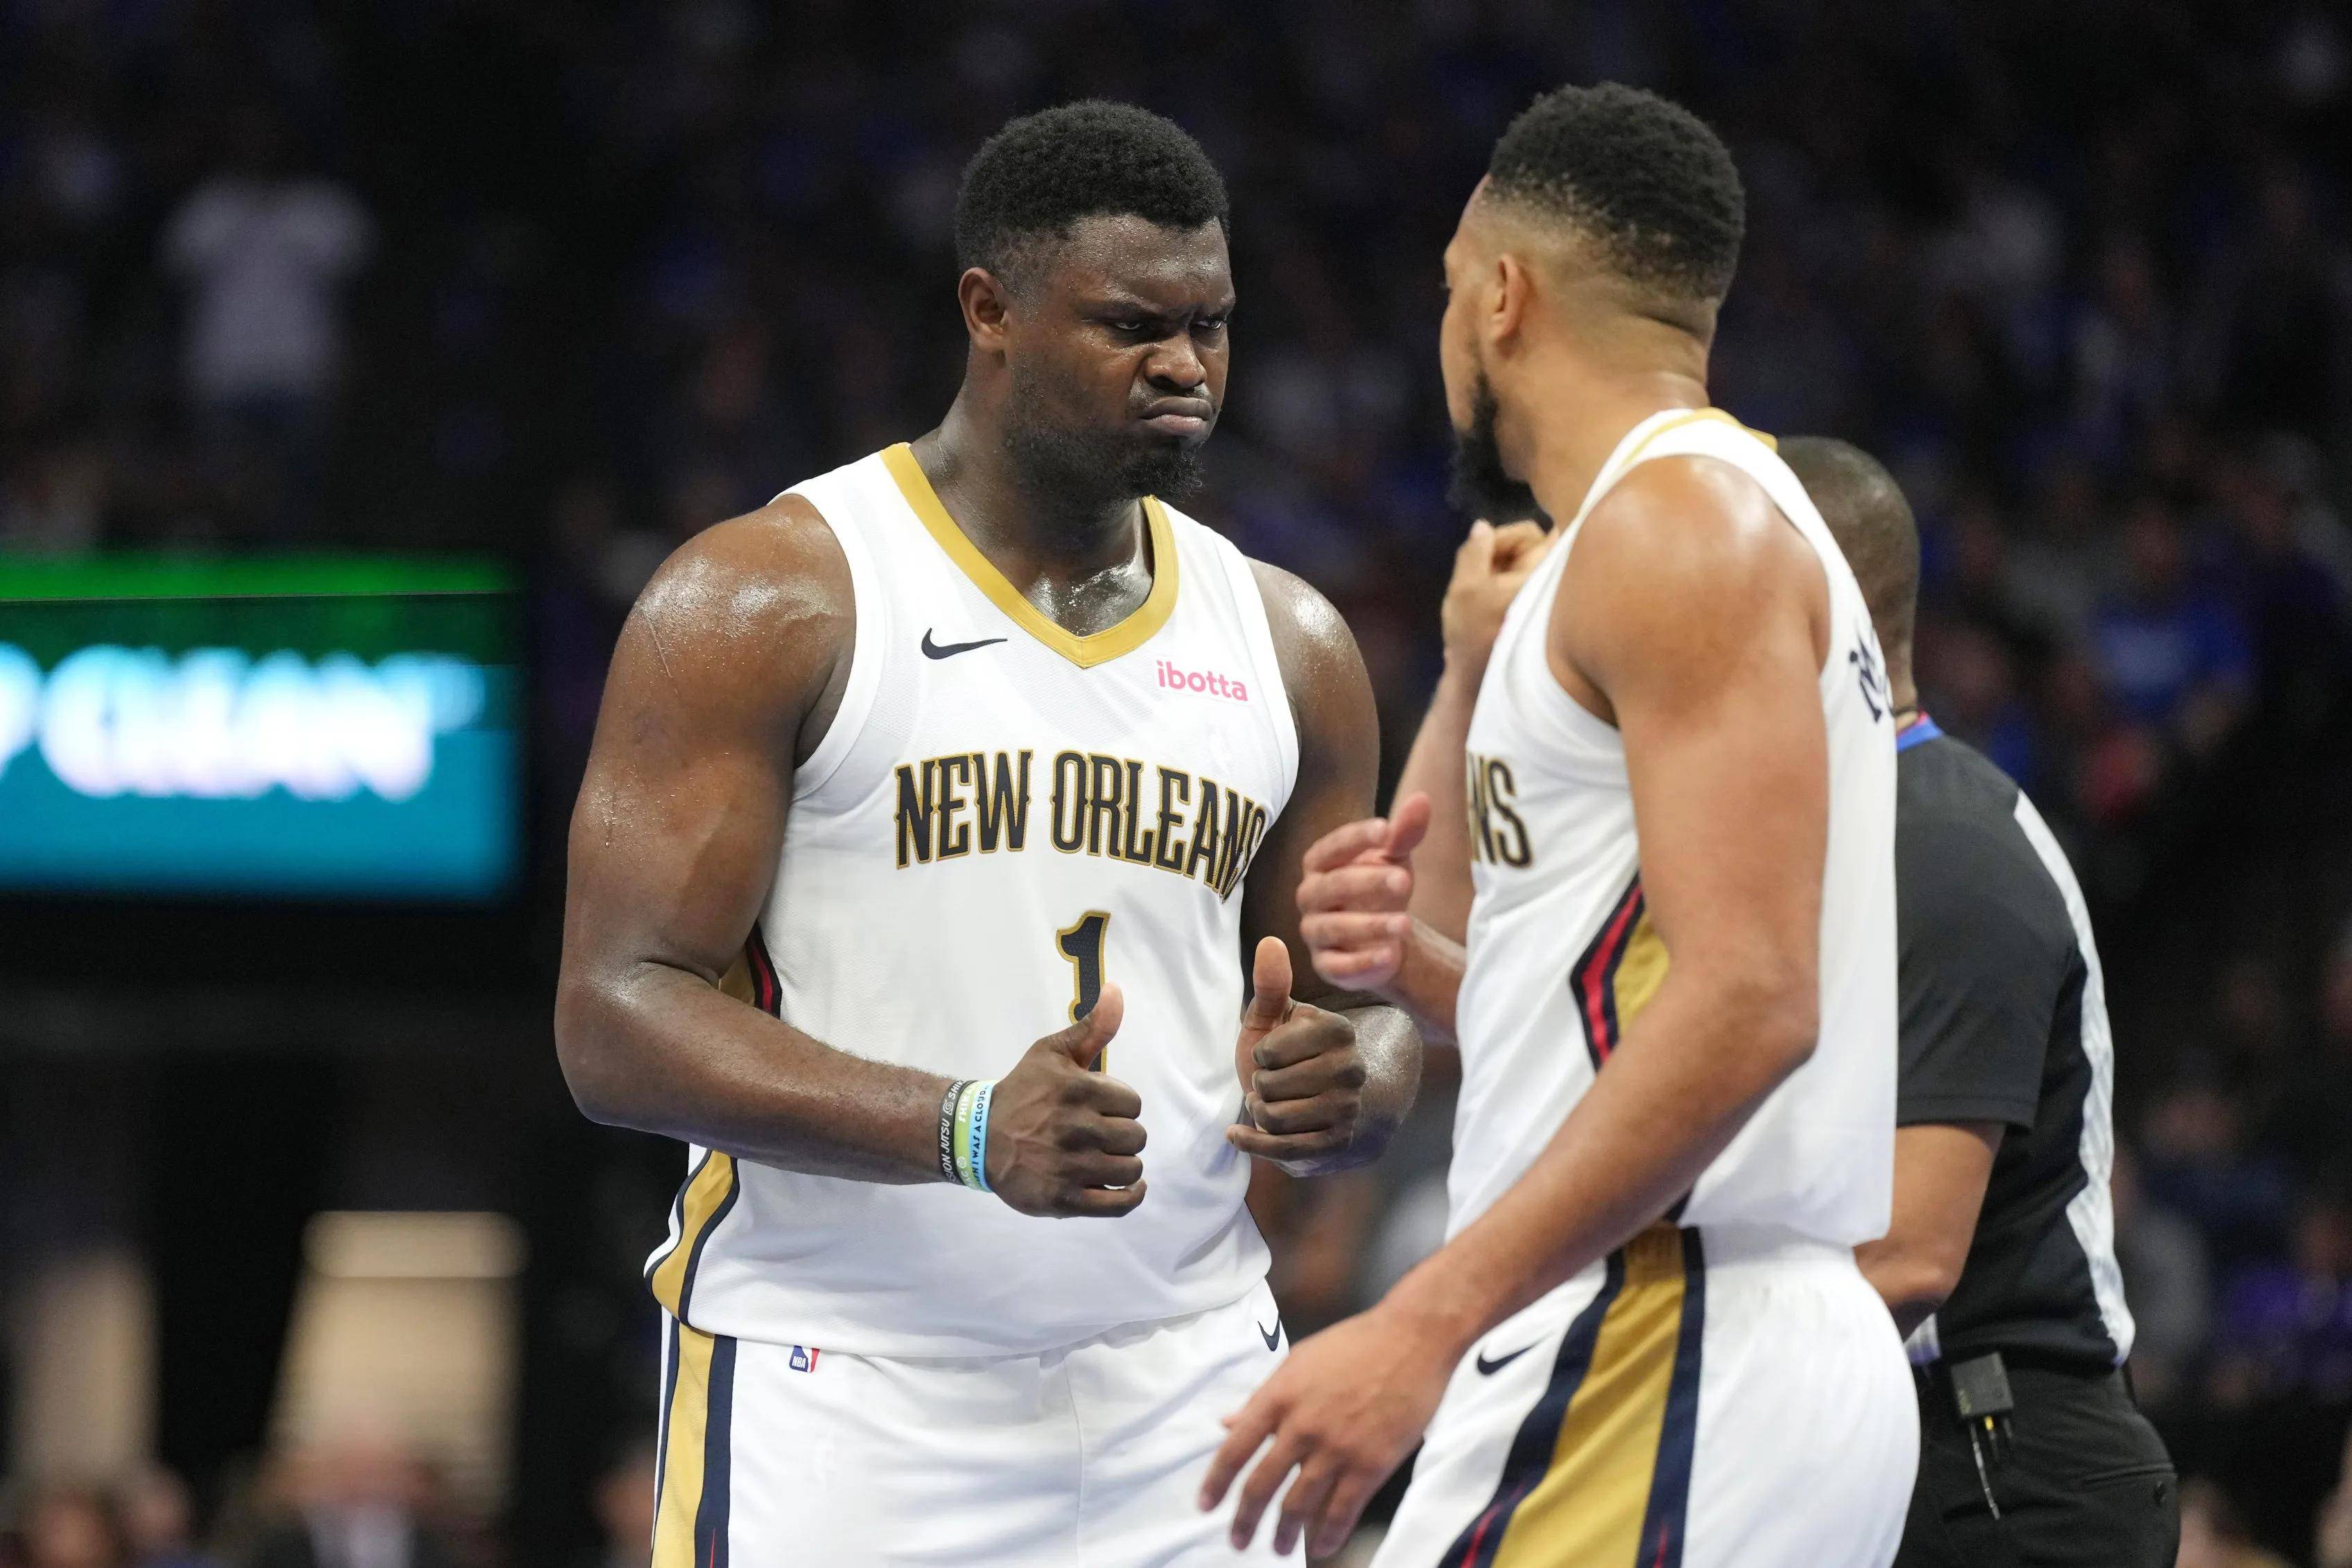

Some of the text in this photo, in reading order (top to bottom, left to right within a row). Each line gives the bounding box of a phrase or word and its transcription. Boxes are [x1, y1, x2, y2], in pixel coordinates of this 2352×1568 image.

[1156, 660, 1248, 702] ibotta
[894, 749, 1266, 904] NEW ORLEANS
[1056, 909, 1111, 1076] 1
[941, 1118, 950, 1153] JUTSU
[792, 1355, 806, 1368] NBA
